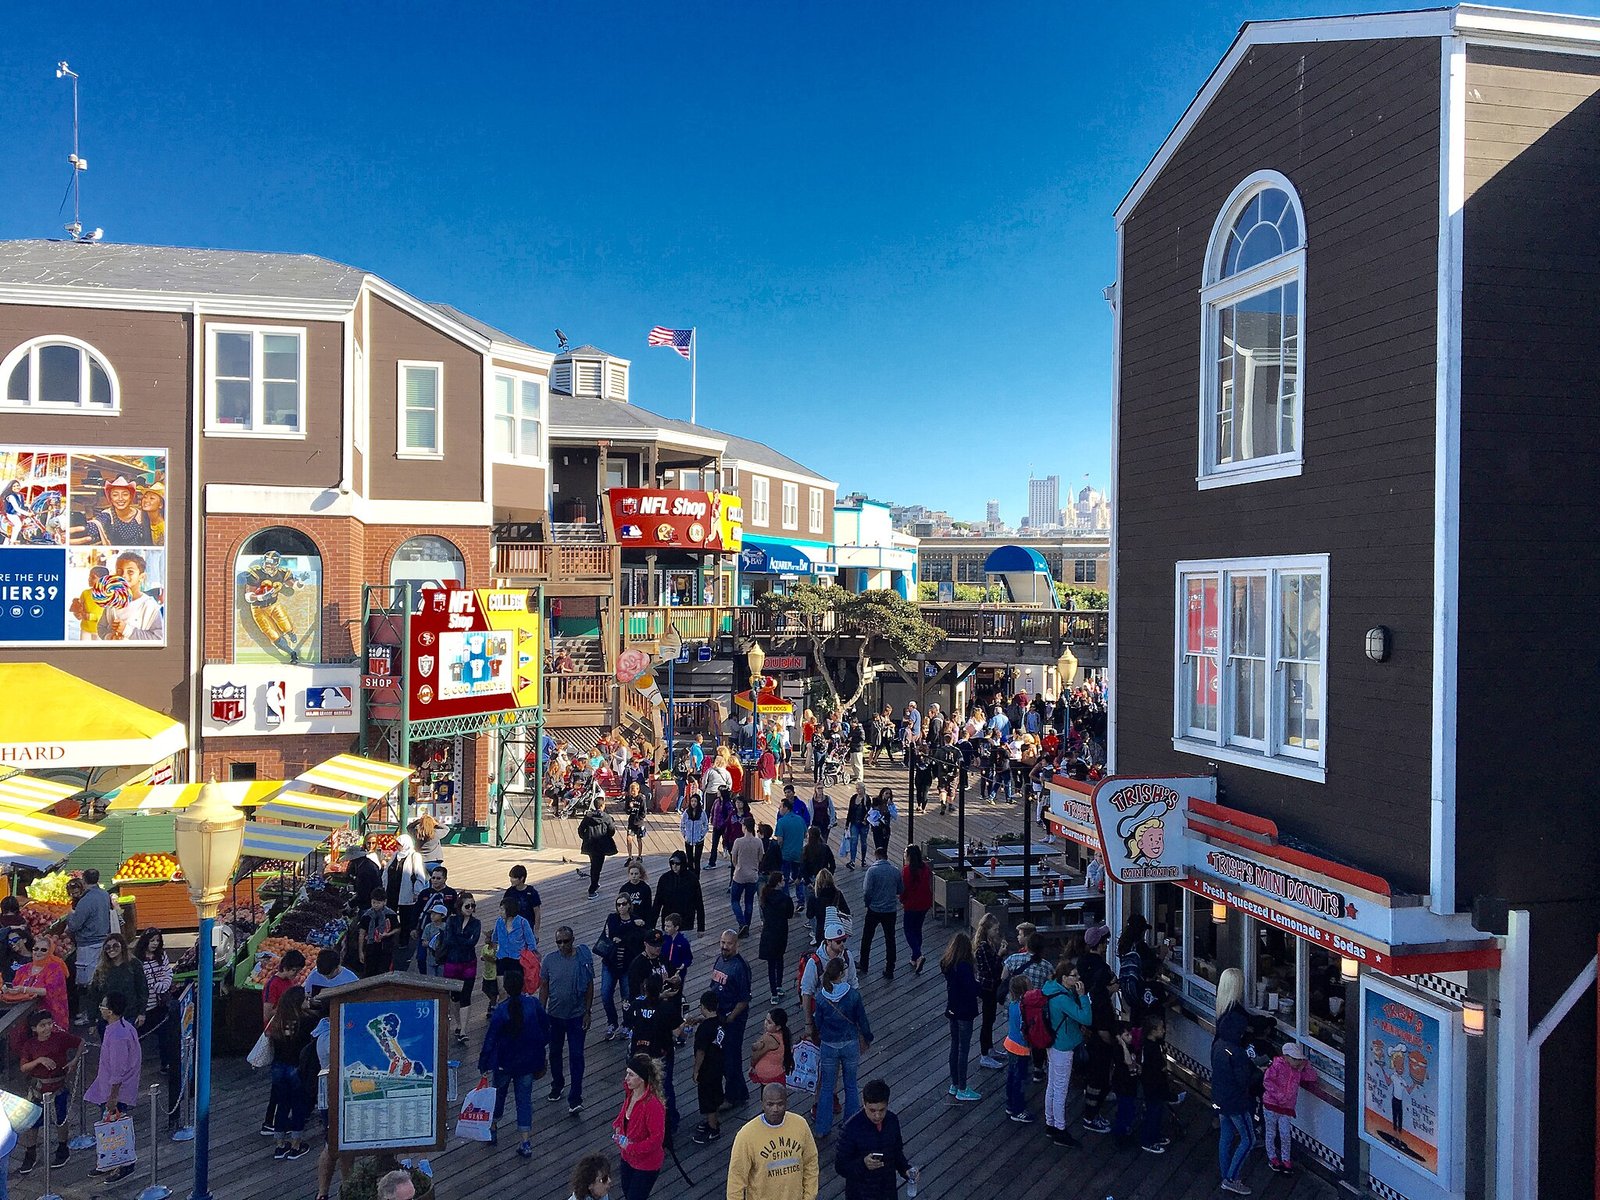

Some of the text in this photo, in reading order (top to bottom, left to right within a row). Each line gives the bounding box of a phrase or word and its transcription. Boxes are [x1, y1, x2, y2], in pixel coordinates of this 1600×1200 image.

[640, 496, 669, 515] NFL
[672, 497, 706, 519] Shop
[0, 573, 59, 582] RE THE FUN
[2, 586, 58, 601] IER39
[448, 590, 476, 613] NFL
[448, 613, 474, 631] Shop
[369, 659, 390, 675] NFL
[764, 657, 803, 669] OUDIN
[365, 678, 392, 688] SHOP
[212, 700, 244, 720] NFL
[1, 746, 65, 761] HARD
[1111, 783, 1179, 812] TRISH'S
[1061, 825, 1086, 843] Gourmet
[1121, 866, 1180, 879] MINI DONUTS
[1212, 852, 1343, 918] TRISH'S MINI DONUTS
[1202, 881, 1367, 960] Fresh Squeezed Lemonade Sodas
[416, 1007, 430, 1019] 39
[760, 1136, 801, 1159] OLD NAVY
[767, 1164, 800, 1178] ATHLETICS
